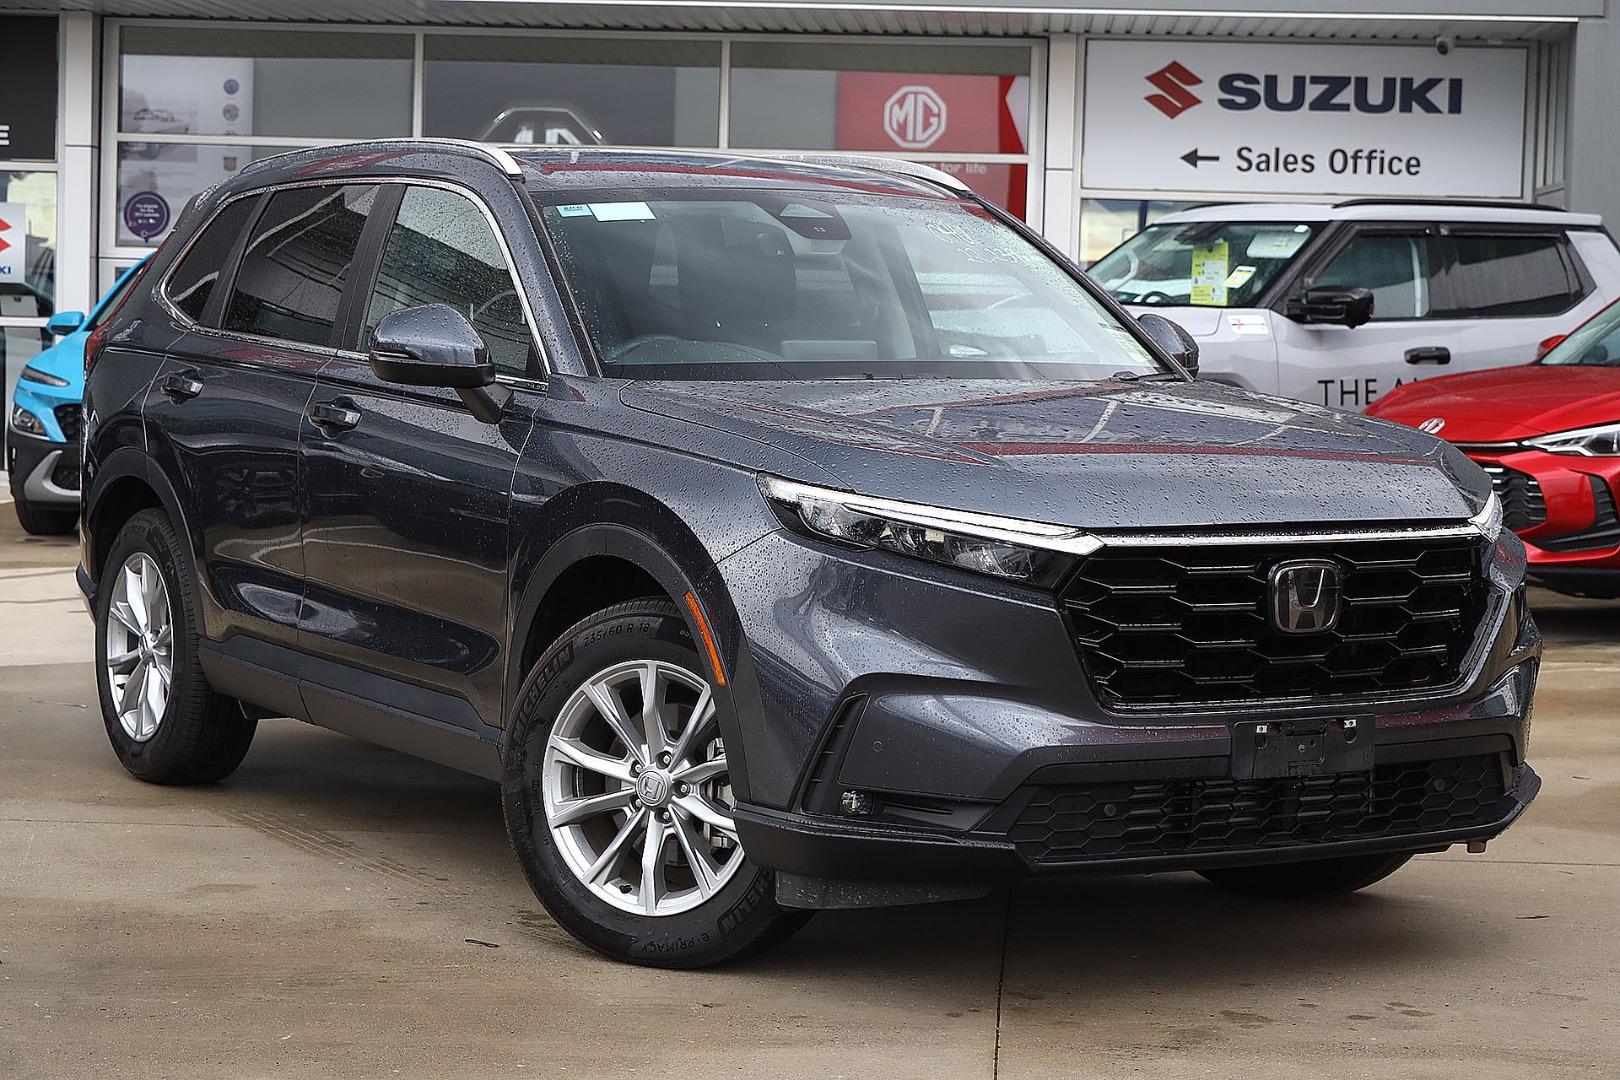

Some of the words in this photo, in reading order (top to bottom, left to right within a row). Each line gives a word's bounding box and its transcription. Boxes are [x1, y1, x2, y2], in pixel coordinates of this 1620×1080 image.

[1217, 73, 1463, 115] SUZUKI
[888, 91, 942, 144] MG
[965, 162, 988, 175] life
[1235, 146, 1316, 174] Sales
[1328, 148, 1422, 176] Office
[1318, 378, 1378, 407] THE
[582, 624, 623, 648] 235/60
[626, 624, 635, 633] R
[638, 622, 650, 633] 18
